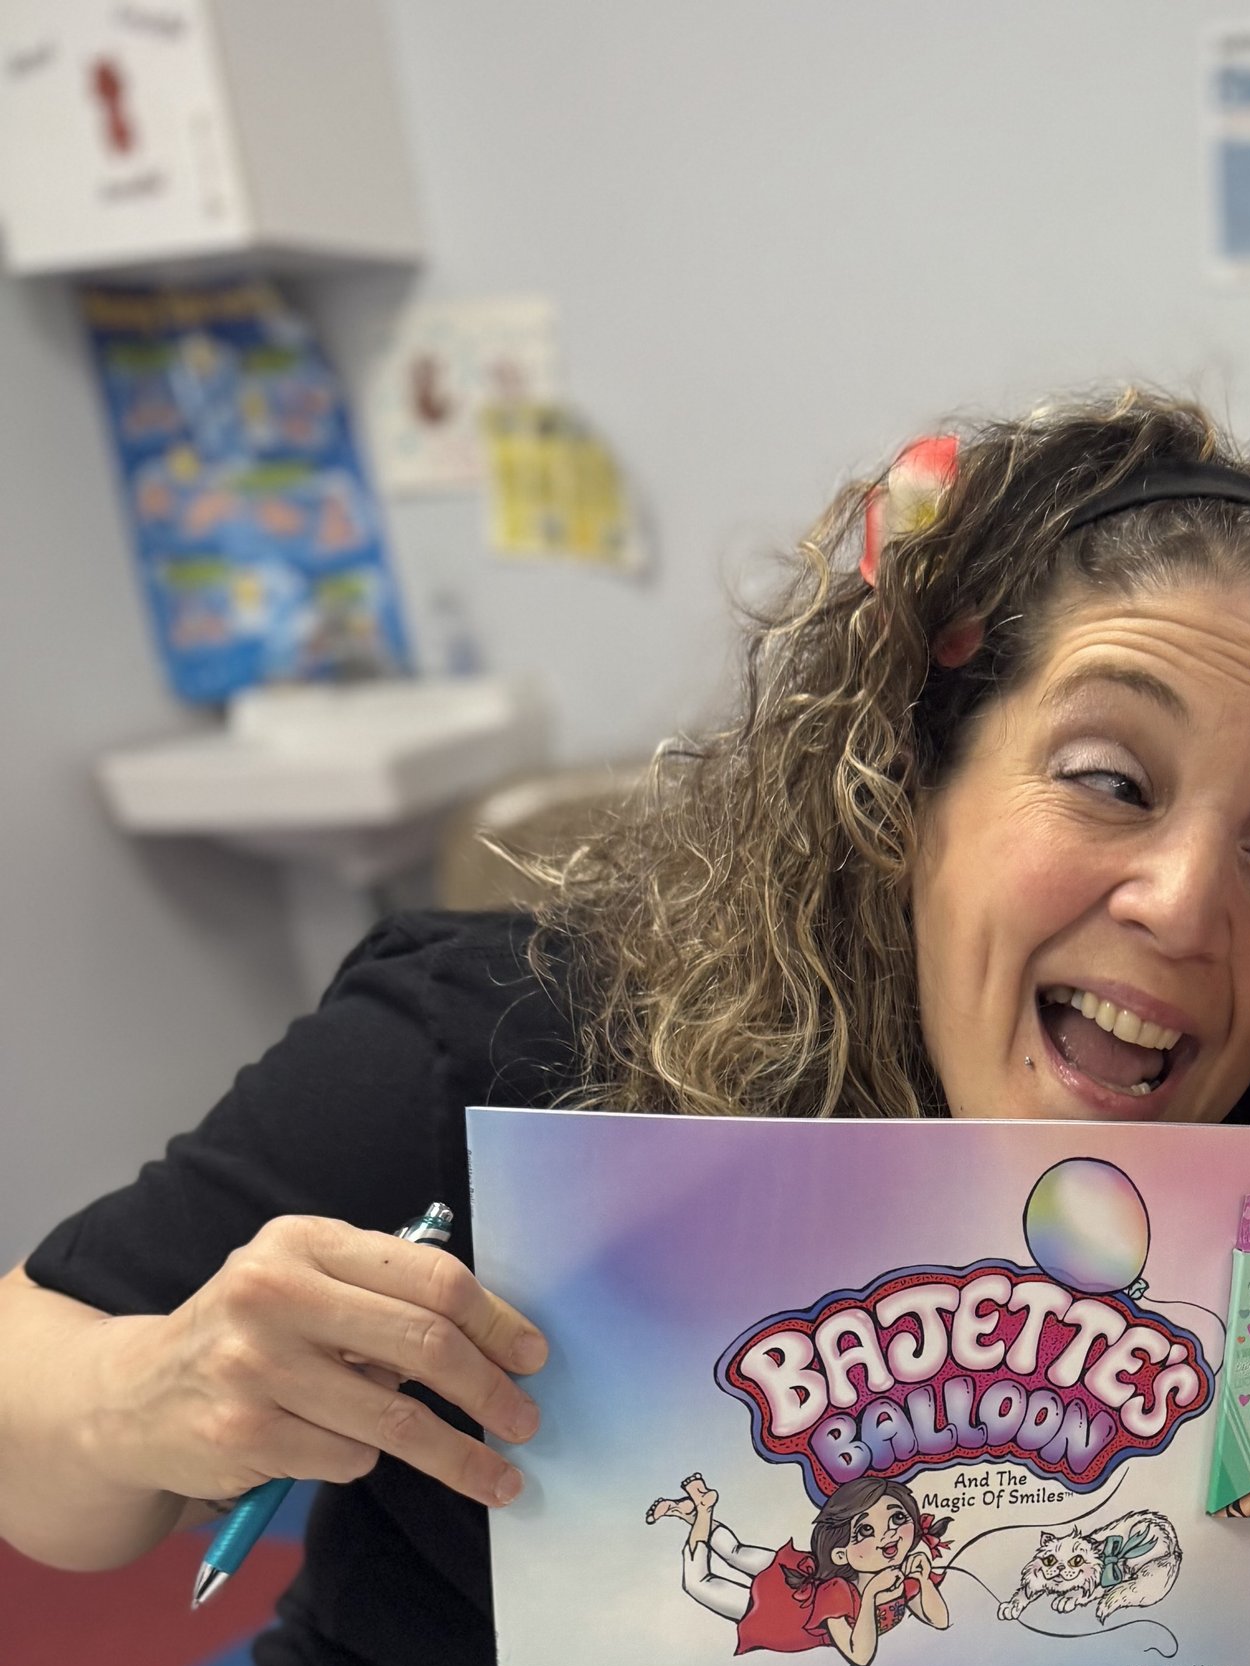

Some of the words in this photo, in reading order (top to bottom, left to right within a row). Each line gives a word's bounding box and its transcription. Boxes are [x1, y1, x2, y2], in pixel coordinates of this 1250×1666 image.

[740, 1274, 1200, 1438] BAJETTE'S
[809, 1375, 1117, 1484] BALLOON
[922, 1492, 976, 1513] Magic
[982, 1489, 1006, 1509] Of
[954, 1471, 990, 1489] And
[996, 1470, 1028, 1486] The
